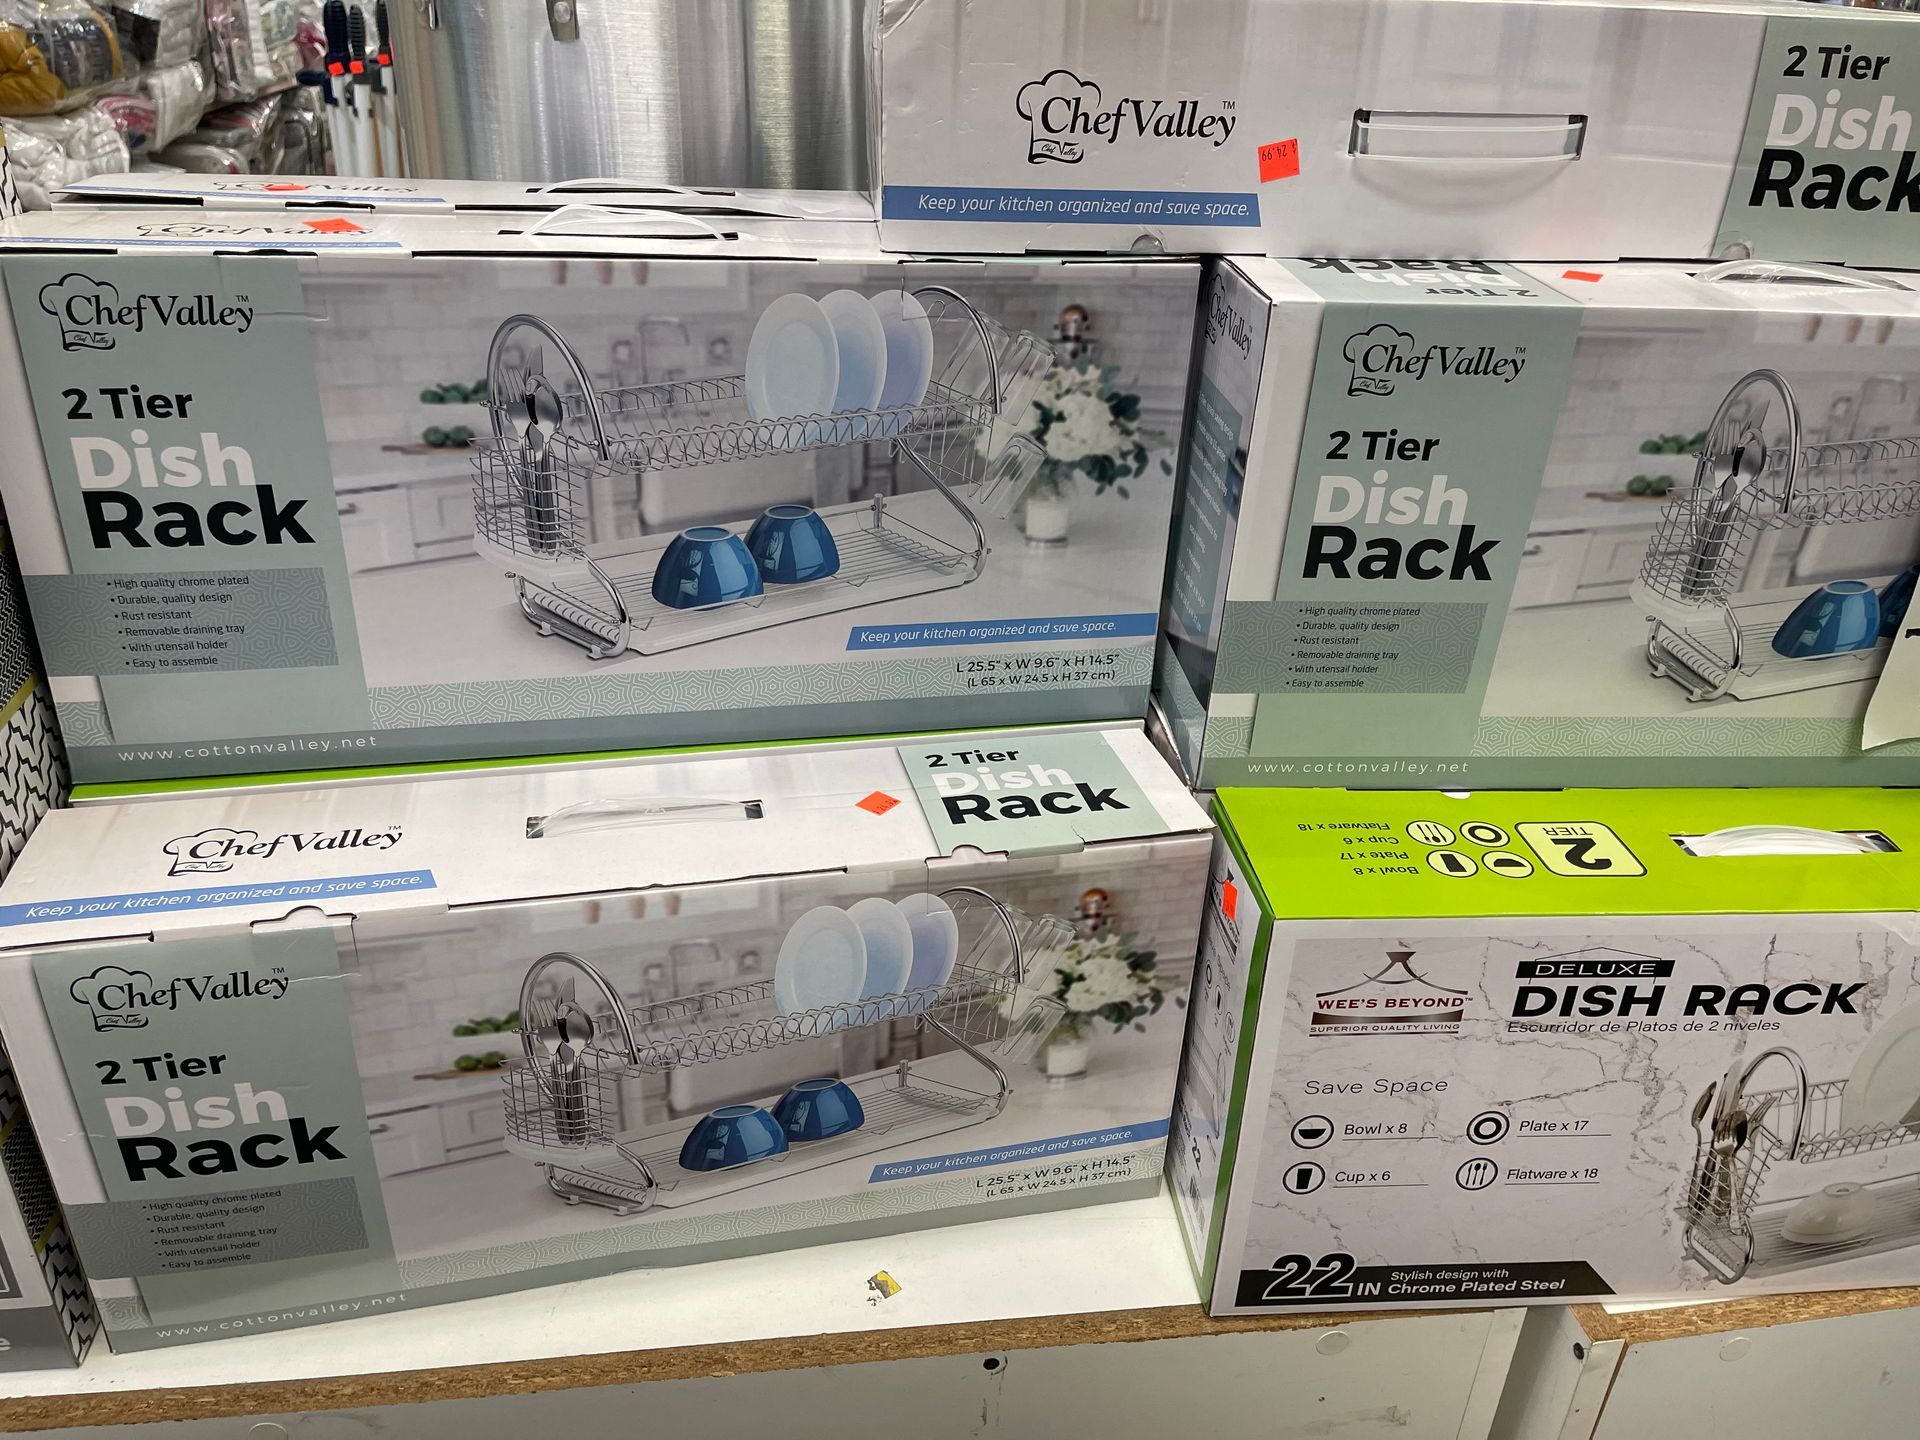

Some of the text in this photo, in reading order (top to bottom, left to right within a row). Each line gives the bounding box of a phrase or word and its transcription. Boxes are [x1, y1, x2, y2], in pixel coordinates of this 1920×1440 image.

[1783, 44, 1890, 80] 2 Tier
[1765, 88, 1912, 151] Dish
[1748, 148, 1920, 213] Rack
[918, 194, 1250, 218] Keep your kitchen organized and save space.
[1356, 272, 1522, 287] Dish
[1425, 288, 1539, 297] 2 Tier
[61, 384, 192, 419] 2 Tier
[1325, 428, 1440, 461] 2 Tier
[70, 429, 256, 488] Dish
[1313, 469, 1468, 525] Dish
[81, 484, 316, 548] Rack
[1302, 524, 1502, 580] Rack
[113, 575, 249, 590] High quality chrome plated
[117, 592, 232, 605] Durable, quality design
[121, 610, 192, 621] Rust resistant
[1305, 607, 1421, 617] High quality chrome plated
[125, 624, 245, 637] Removable draining tray
[860, 621, 1117, 644] Keep your kitchen organized and save space.
[1302, 622, 1400, 632] Durable, quality design
[128, 643, 152, 652] With
[197, 640, 228, 650] holder
[1299, 636, 1359, 645] Rust resistant
[132, 655, 218, 669] Easy to assemble
[1016, 658, 1032, 670] W
[1075, 655, 1086, 667] H
[1296, 651, 1399, 660] Removable draining tray
[1294, 665, 1314, 674] With
[1352, 665, 1378, 674] holder
[980, 676, 996, 687] 65
[1009, 675, 1022, 685] W
[1024, 673, 1048, 685] 24.5
[1062, 672, 1071, 682] H
[1073, 671, 1088, 681] 37
[1091, 670, 1115, 681] cm)
[1291, 679, 1312, 689] Easy
[1324, 679, 1364, 688] assemble
[118, 735, 377, 762] www.cottonvalley.net
[925, 750, 1019, 768] 2 Tier
[1248, 761, 1469, 775] www.cottonvalley.net
[931, 764, 1077, 797] Dish
[941, 783, 1131, 825] Rack
[1328, 822, 1391, 830] Flatware
[1542, 827, 1593, 835] TIER
[1368, 835, 1400, 845] Cup
[1369, 851, 1410, 860] Plate
[1550, 838, 1612, 870] 2
[1379, 866, 1420, 875] Bowl
[1535, 963, 1656, 976] DELUXE
[1317, 997, 1464, 1010] WEE'S BEYOND
[1512, 982, 1868, 1018] DISH RACK
[1310, 1023, 1460, 1033] SUPERIOR QUALITY LIVING
[1507, 1019, 1781, 1033] Escurridor de Platos de 2 niveles
[95, 1052, 227, 1085] 2 Tier
[1304, 1078, 1448, 1097] Save Space
[104, 1082, 289, 1137] Dish
[1344, 1123, 1408, 1136] Bowl x 8
[1519, 1120, 1590, 1132] Plate x 17
[117, 1117, 348, 1182] Rack
[1334, 1170, 1391, 1185] Cup x 6
[1507, 1167, 1599, 1180] Flatware x 18
[1262, 1252, 1382, 1300] 22 IN
[1390, 1268, 1509, 1282] Stylish design with
[1387, 1278, 1566, 1295] Chrome Plated Steel
[156, 1293, 407, 1339] www.cottonvalley.net
